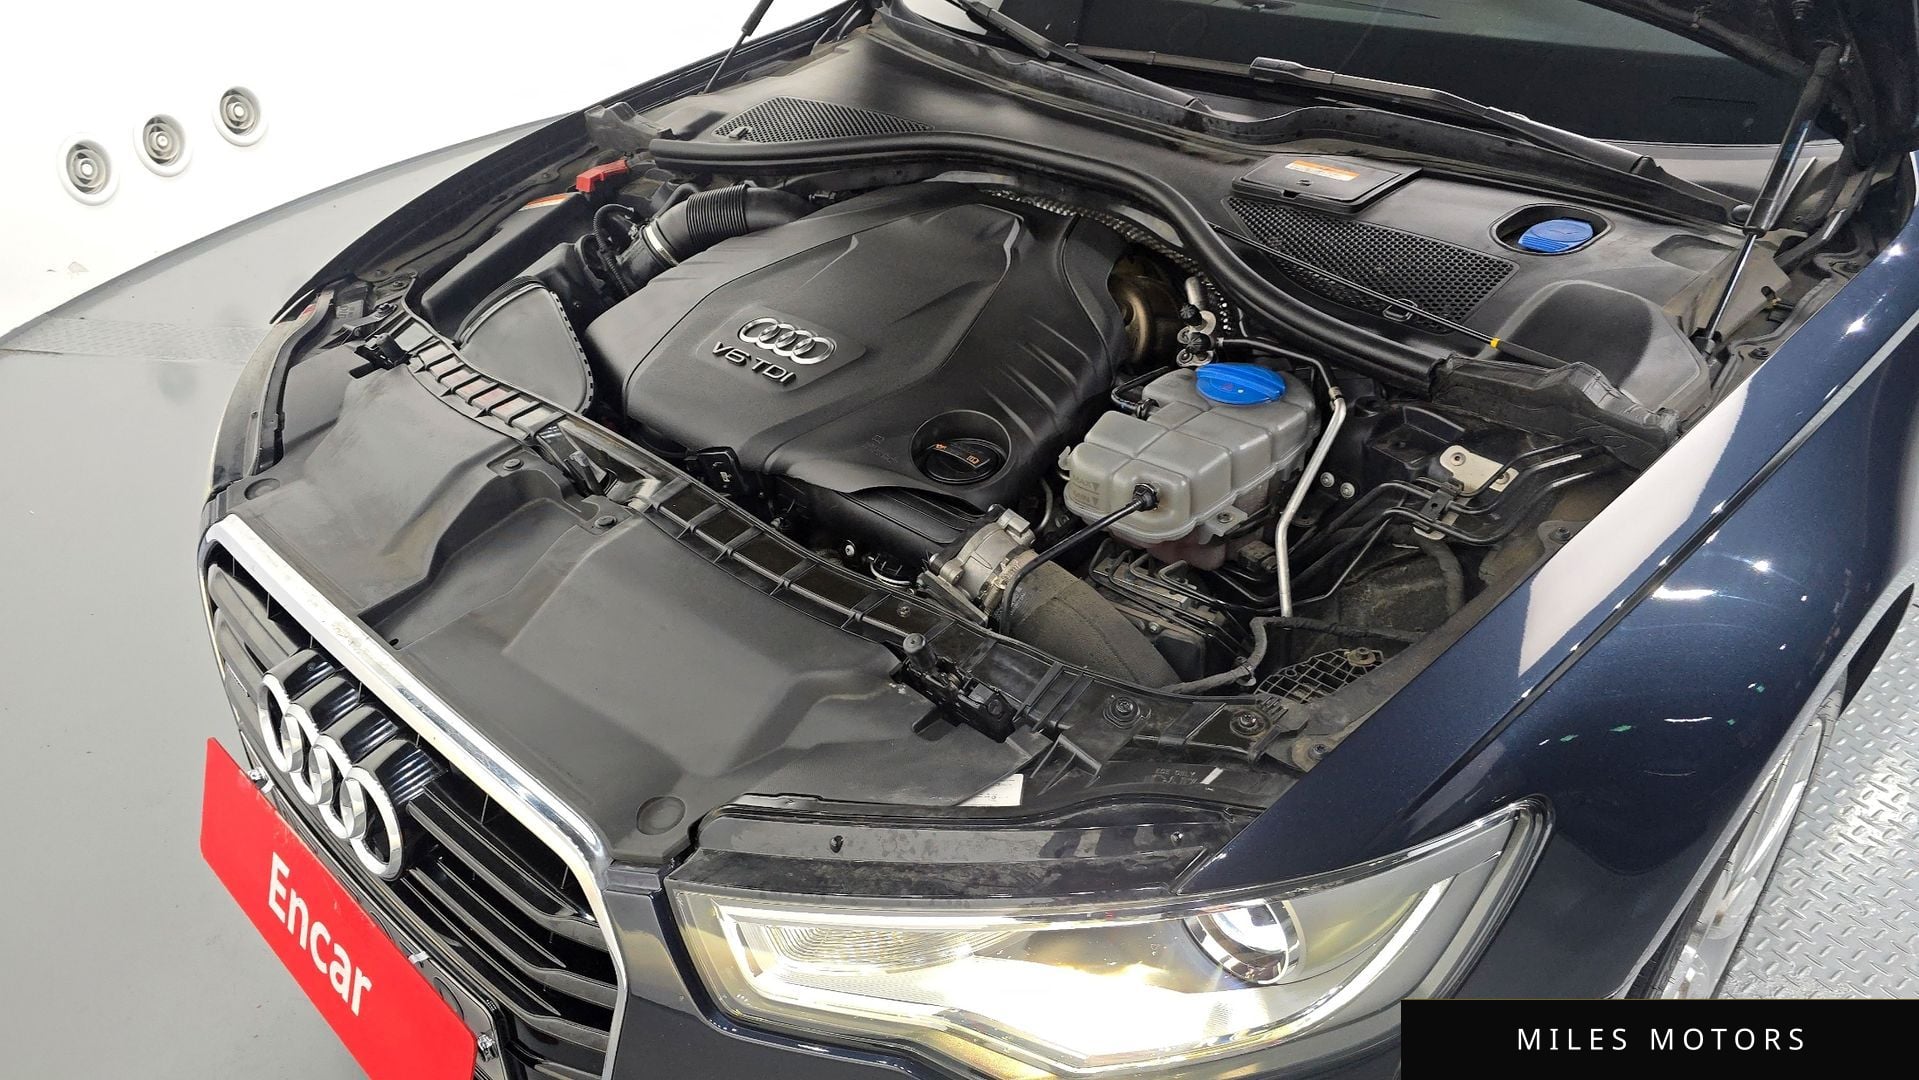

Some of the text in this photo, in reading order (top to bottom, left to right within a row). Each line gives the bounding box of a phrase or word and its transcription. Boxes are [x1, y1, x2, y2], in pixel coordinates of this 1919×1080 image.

[712, 341, 796, 384] V6 TDI
[268, 851, 373, 1017] Encar
